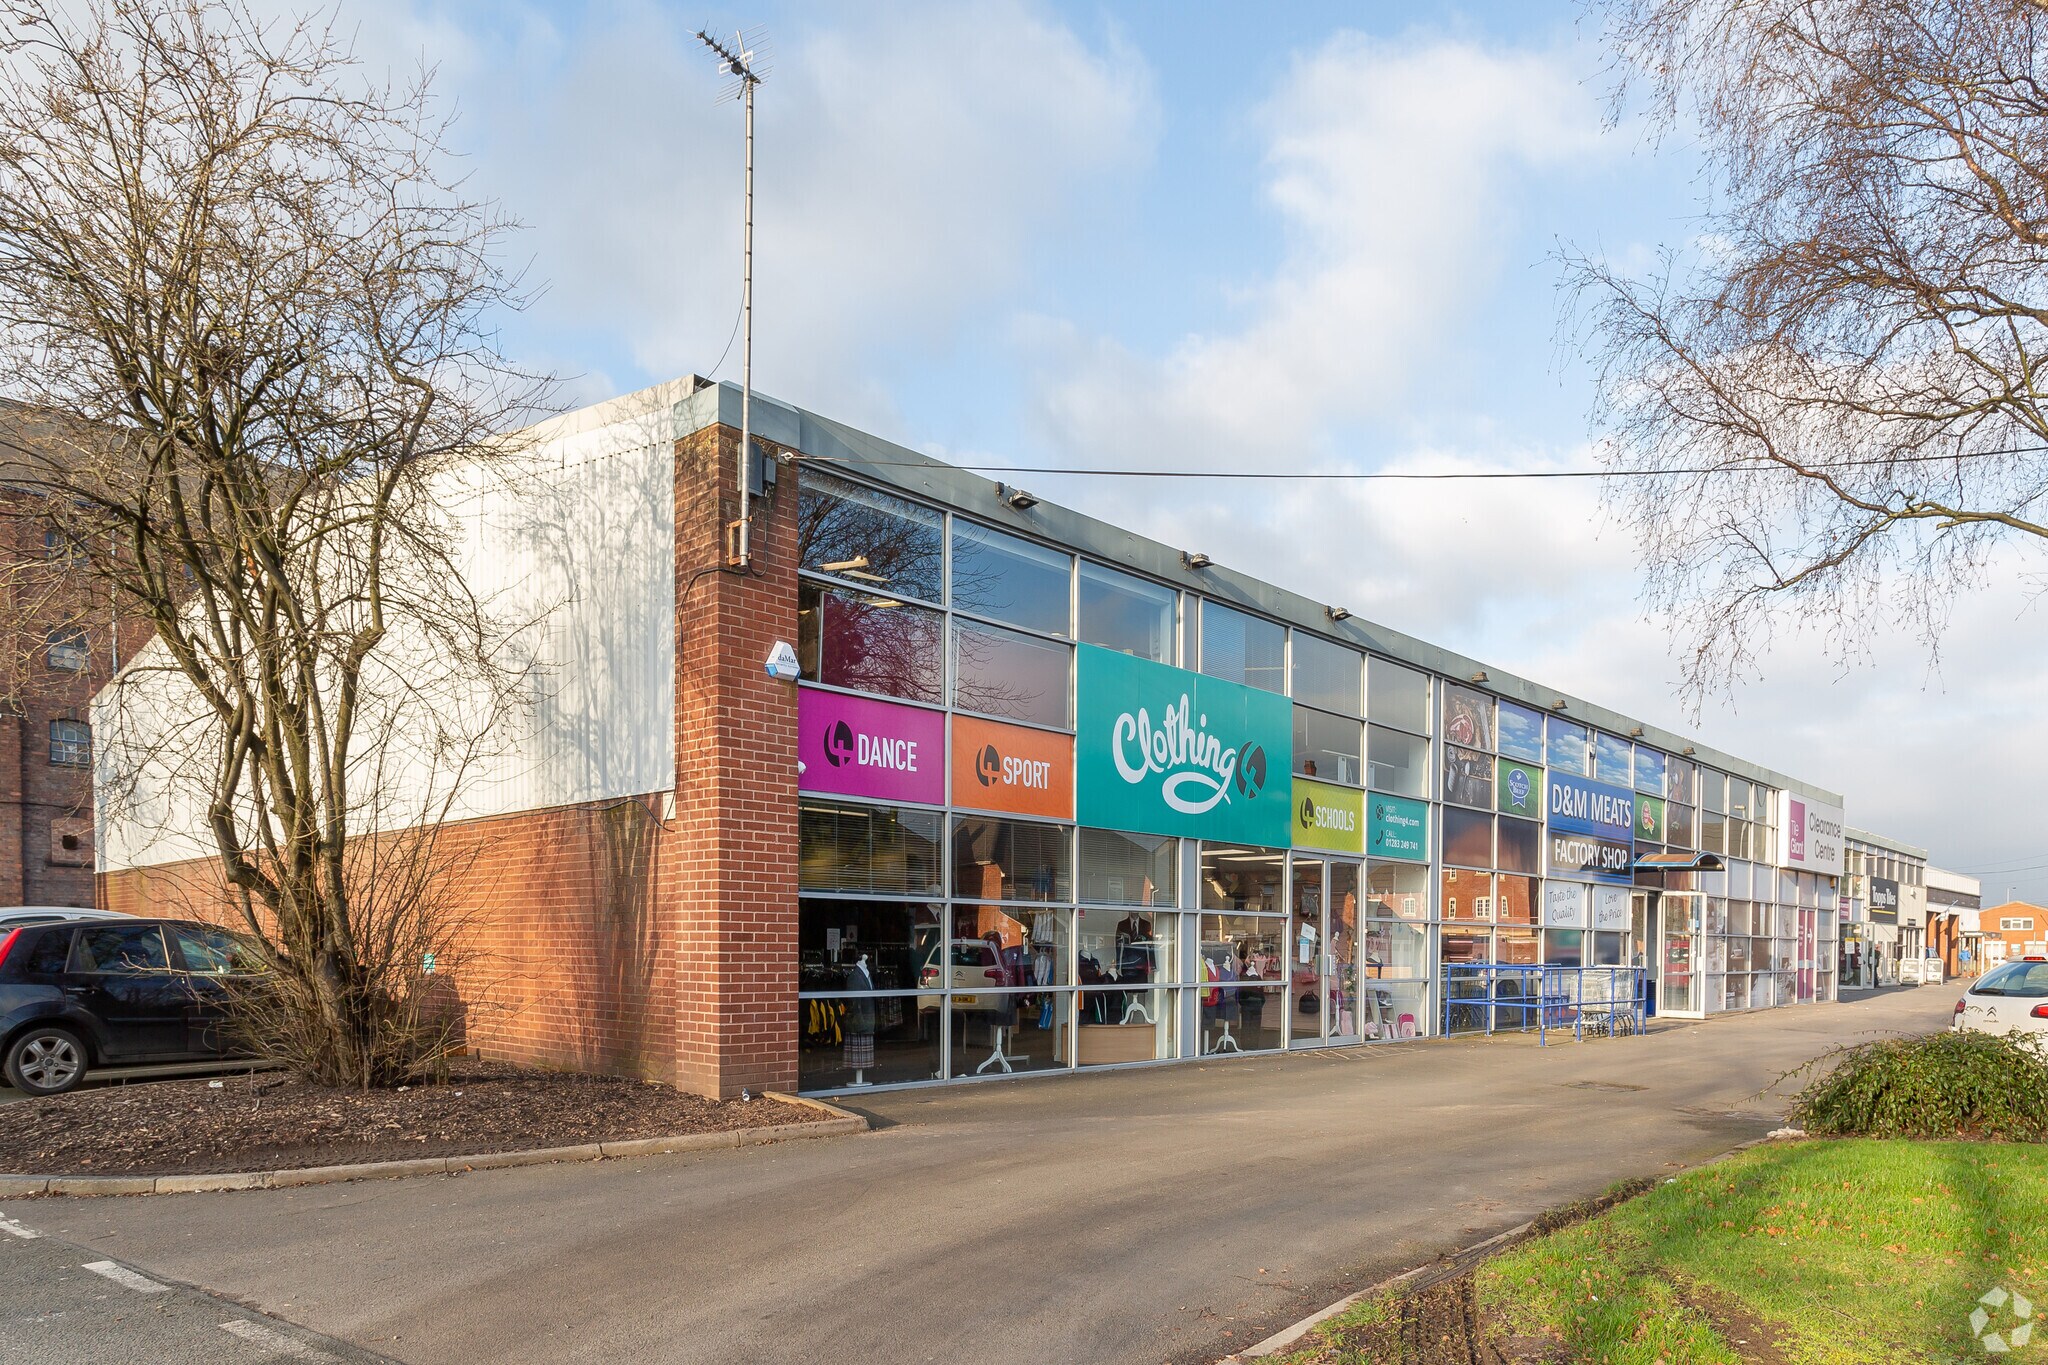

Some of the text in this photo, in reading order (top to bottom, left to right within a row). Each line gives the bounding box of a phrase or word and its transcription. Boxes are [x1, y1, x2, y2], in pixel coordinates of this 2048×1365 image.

[858, 733, 918, 772] DANCE
[1112, 693, 1237, 814] Clothing
[1003, 756, 1051, 790] SPORT
[1552, 783, 1588, 819] D&M
[1591, 792, 1632, 828] MEATS
[1315, 805, 1355, 832] SCHOOLS
[1385, 813, 1420, 827] clothing4.com
[1790, 819, 1800, 837] Tile
[1809, 812, 1841, 839] Clearance
[1385, 838, 1419, 851] 01283 249 741
[1555, 838, 1628, 871] FACTORY SHOP
[1790, 837, 1804, 856] Giant
[1814, 839, 1835, 862] Centre
[1549, 886, 1577, 904] Taste the
[1605, 892, 1618, 905] Love
[1871, 885, 1897, 906] Topps Tiles
[1552, 905, 1576, 923] Quality
[1608, 907, 1623, 920] Price
